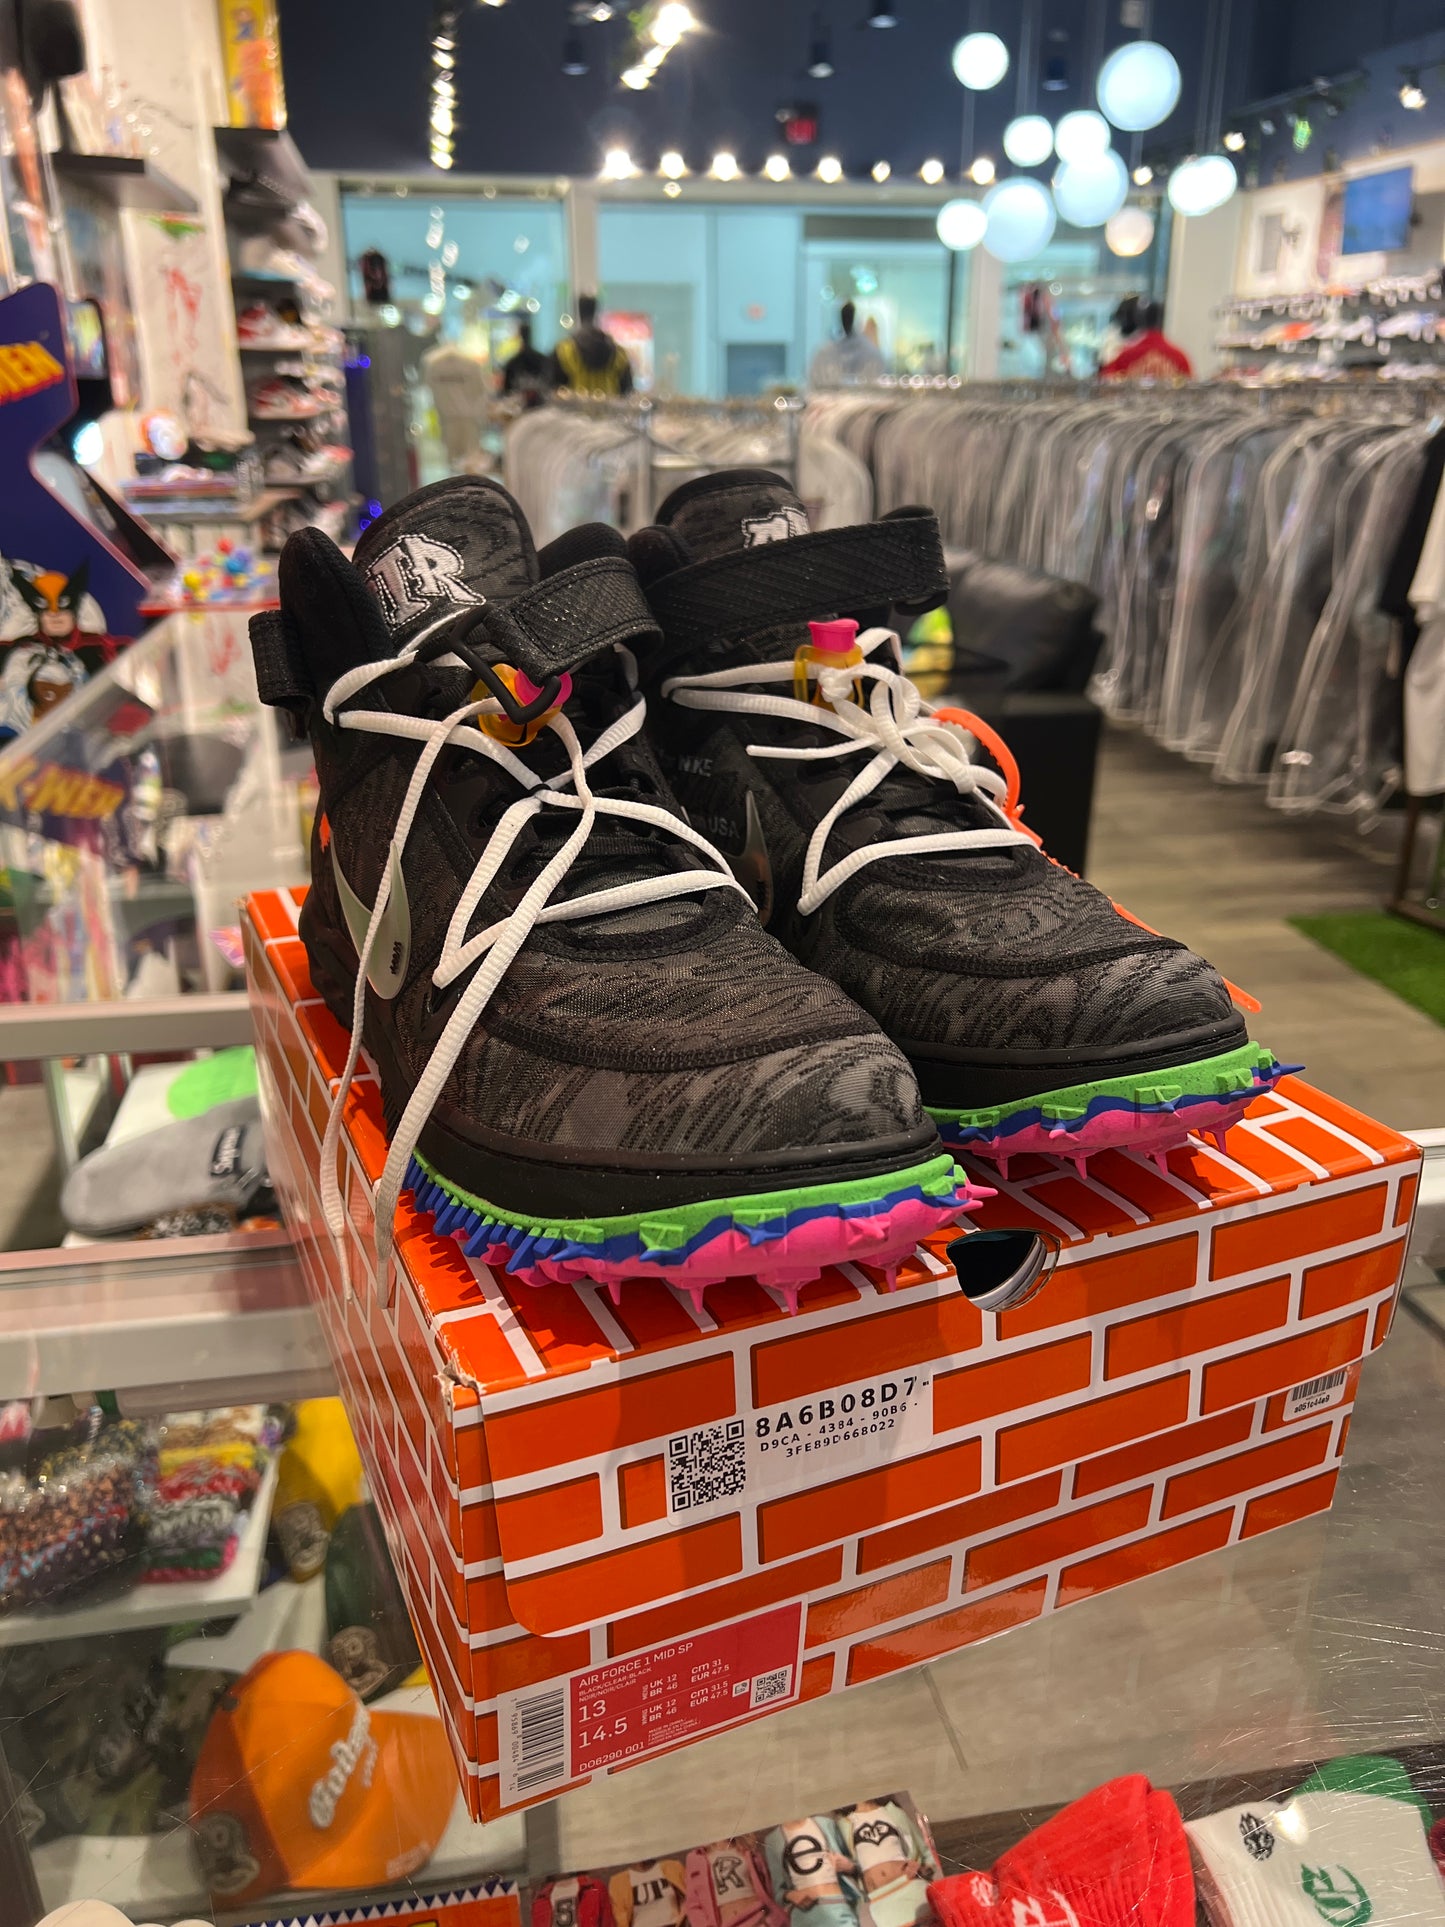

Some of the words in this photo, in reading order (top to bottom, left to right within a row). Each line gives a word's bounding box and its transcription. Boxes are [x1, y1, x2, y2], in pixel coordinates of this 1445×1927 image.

[760, 1433, 800, 1452] D9CA
[819, 1417, 854, 1435] 4384
[872, 1402, 907, 1420] 90B6
[786, 1418, 895, 1458] 3FE89D668022
[579, 1674, 599, 1688] AIR
[602, 1661, 641, 1680] FORCE
[653, 1648, 675, 1663] MID
[678, 1642, 694, 1654] SP
[691, 1662, 710, 1674] cm
[712, 1658, 722, 1668] 31
[691, 1671, 710, 1683] EUR
[712, 1664, 730, 1675] 47.5
[650, 1678, 664, 1689] UK
[666, 1673, 678, 1682] 12
[650, 1687, 663, 1697] BR
[666, 1681, 678, 1691] 46
[690, 1687, 709, 1699] cm
[711, 1681, 728, 1692] 31.5
[649, 1703, 663, 1714] UK
[666, 1699, 677, 1708] 12
[690, 1696, 709, 1708] EUR
[710, 1689, 728, 1701] 47.5
[578, 1700, 606, 1723] 13
[649, 1713, 662, 1722] BR
[666, 1707, 677, 1716] 46
[578, 1716, 628, 1749] 14.5
[625, 1741, 644, 1754] 001
[783, 1834, 824, 1875] e
